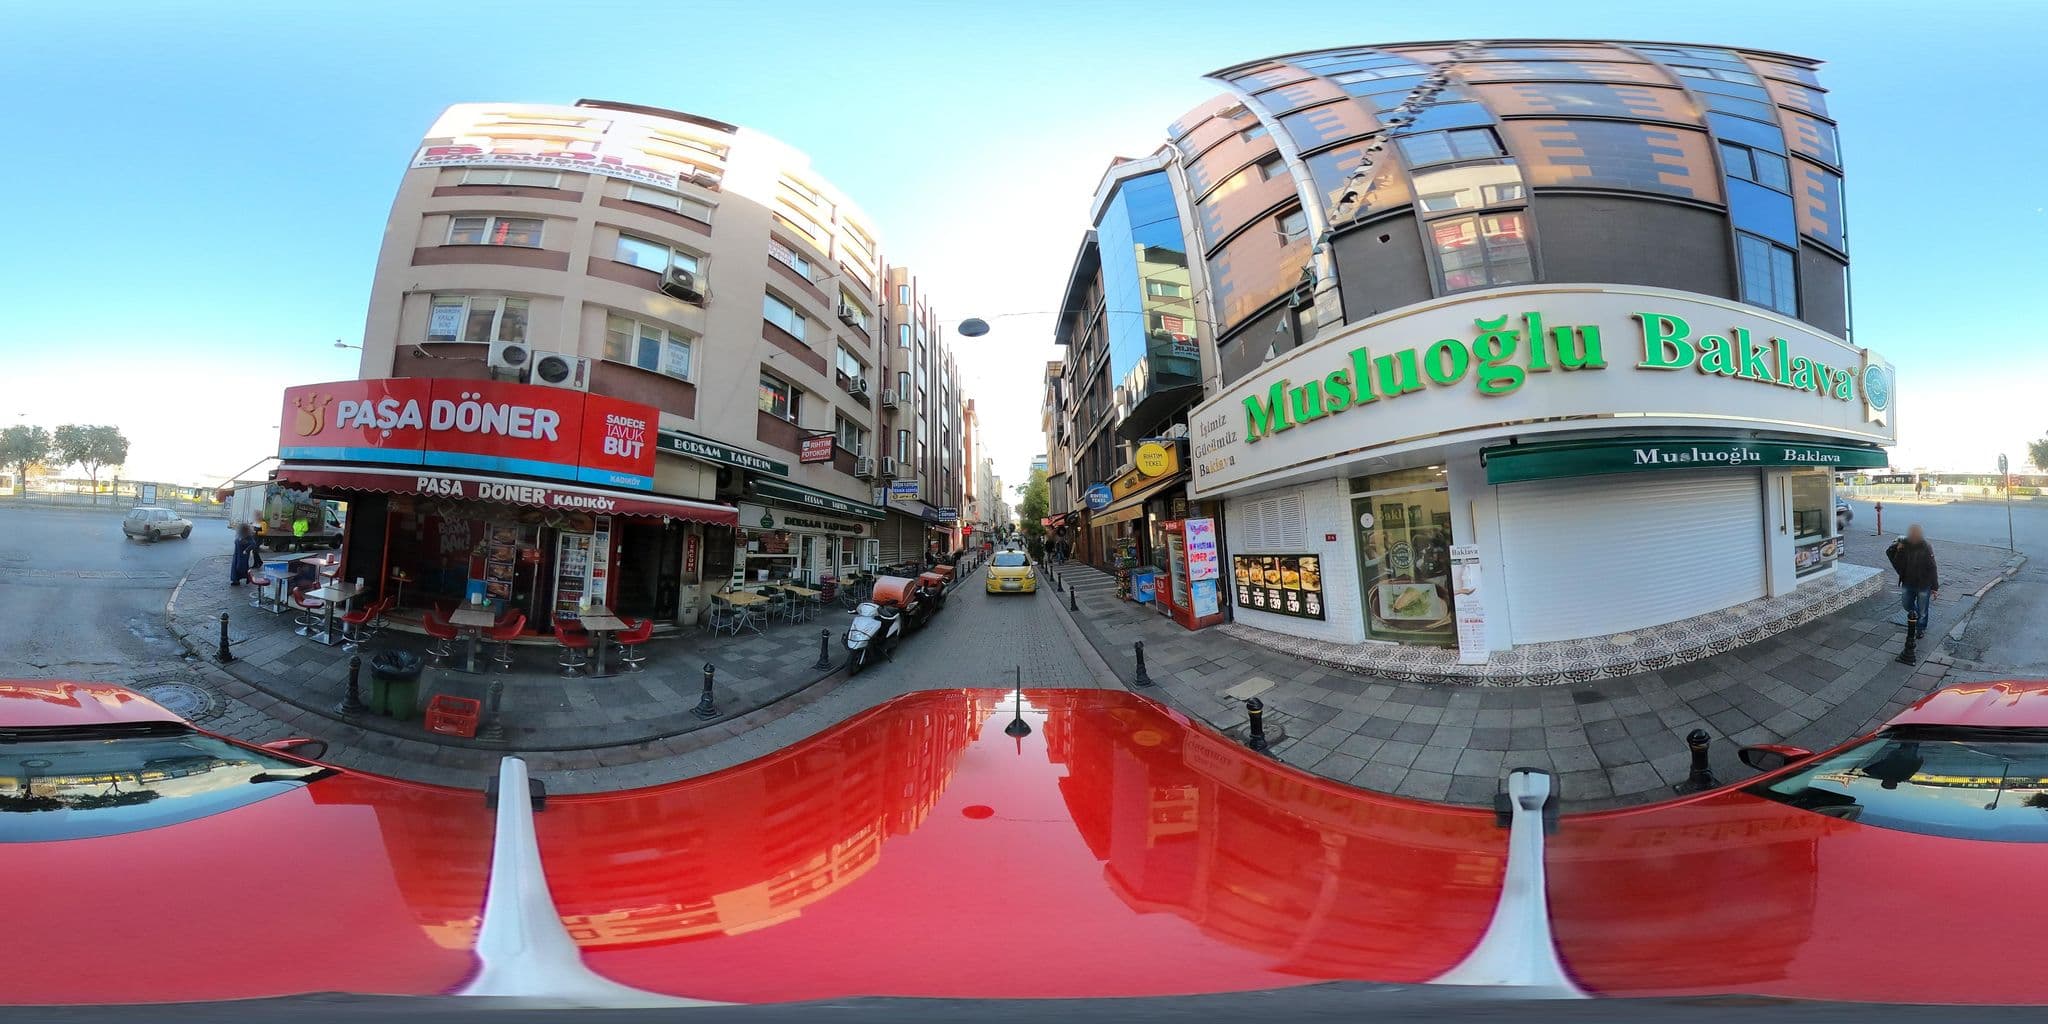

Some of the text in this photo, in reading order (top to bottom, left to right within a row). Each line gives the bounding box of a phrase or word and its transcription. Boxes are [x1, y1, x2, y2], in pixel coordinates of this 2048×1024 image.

[1242, 312, 1855, 443] Musluoğlu Baklava
[336, 391, 560, 442] PAŞA DÖNER
[606, 414, 645, 430] SADECE
[1200, 414, 1227, 438] İşimiz
[606, 422, 645, 442] TAVUK
[603, 436, 645, 459] BUT
[674, 438, 721, 458] BORSAM
[1195, 431, 1238, 459] Gücümüz
[1633, 448, 1841, 464] Musluoğlu Baklava
[1200, 455, 1235, 477] Baklava
[609, 474, 640, 486] KADIKÖY
[478, 481, 546, 504] DÖNER
[553, 494, 615, 510] KADIKÖY
